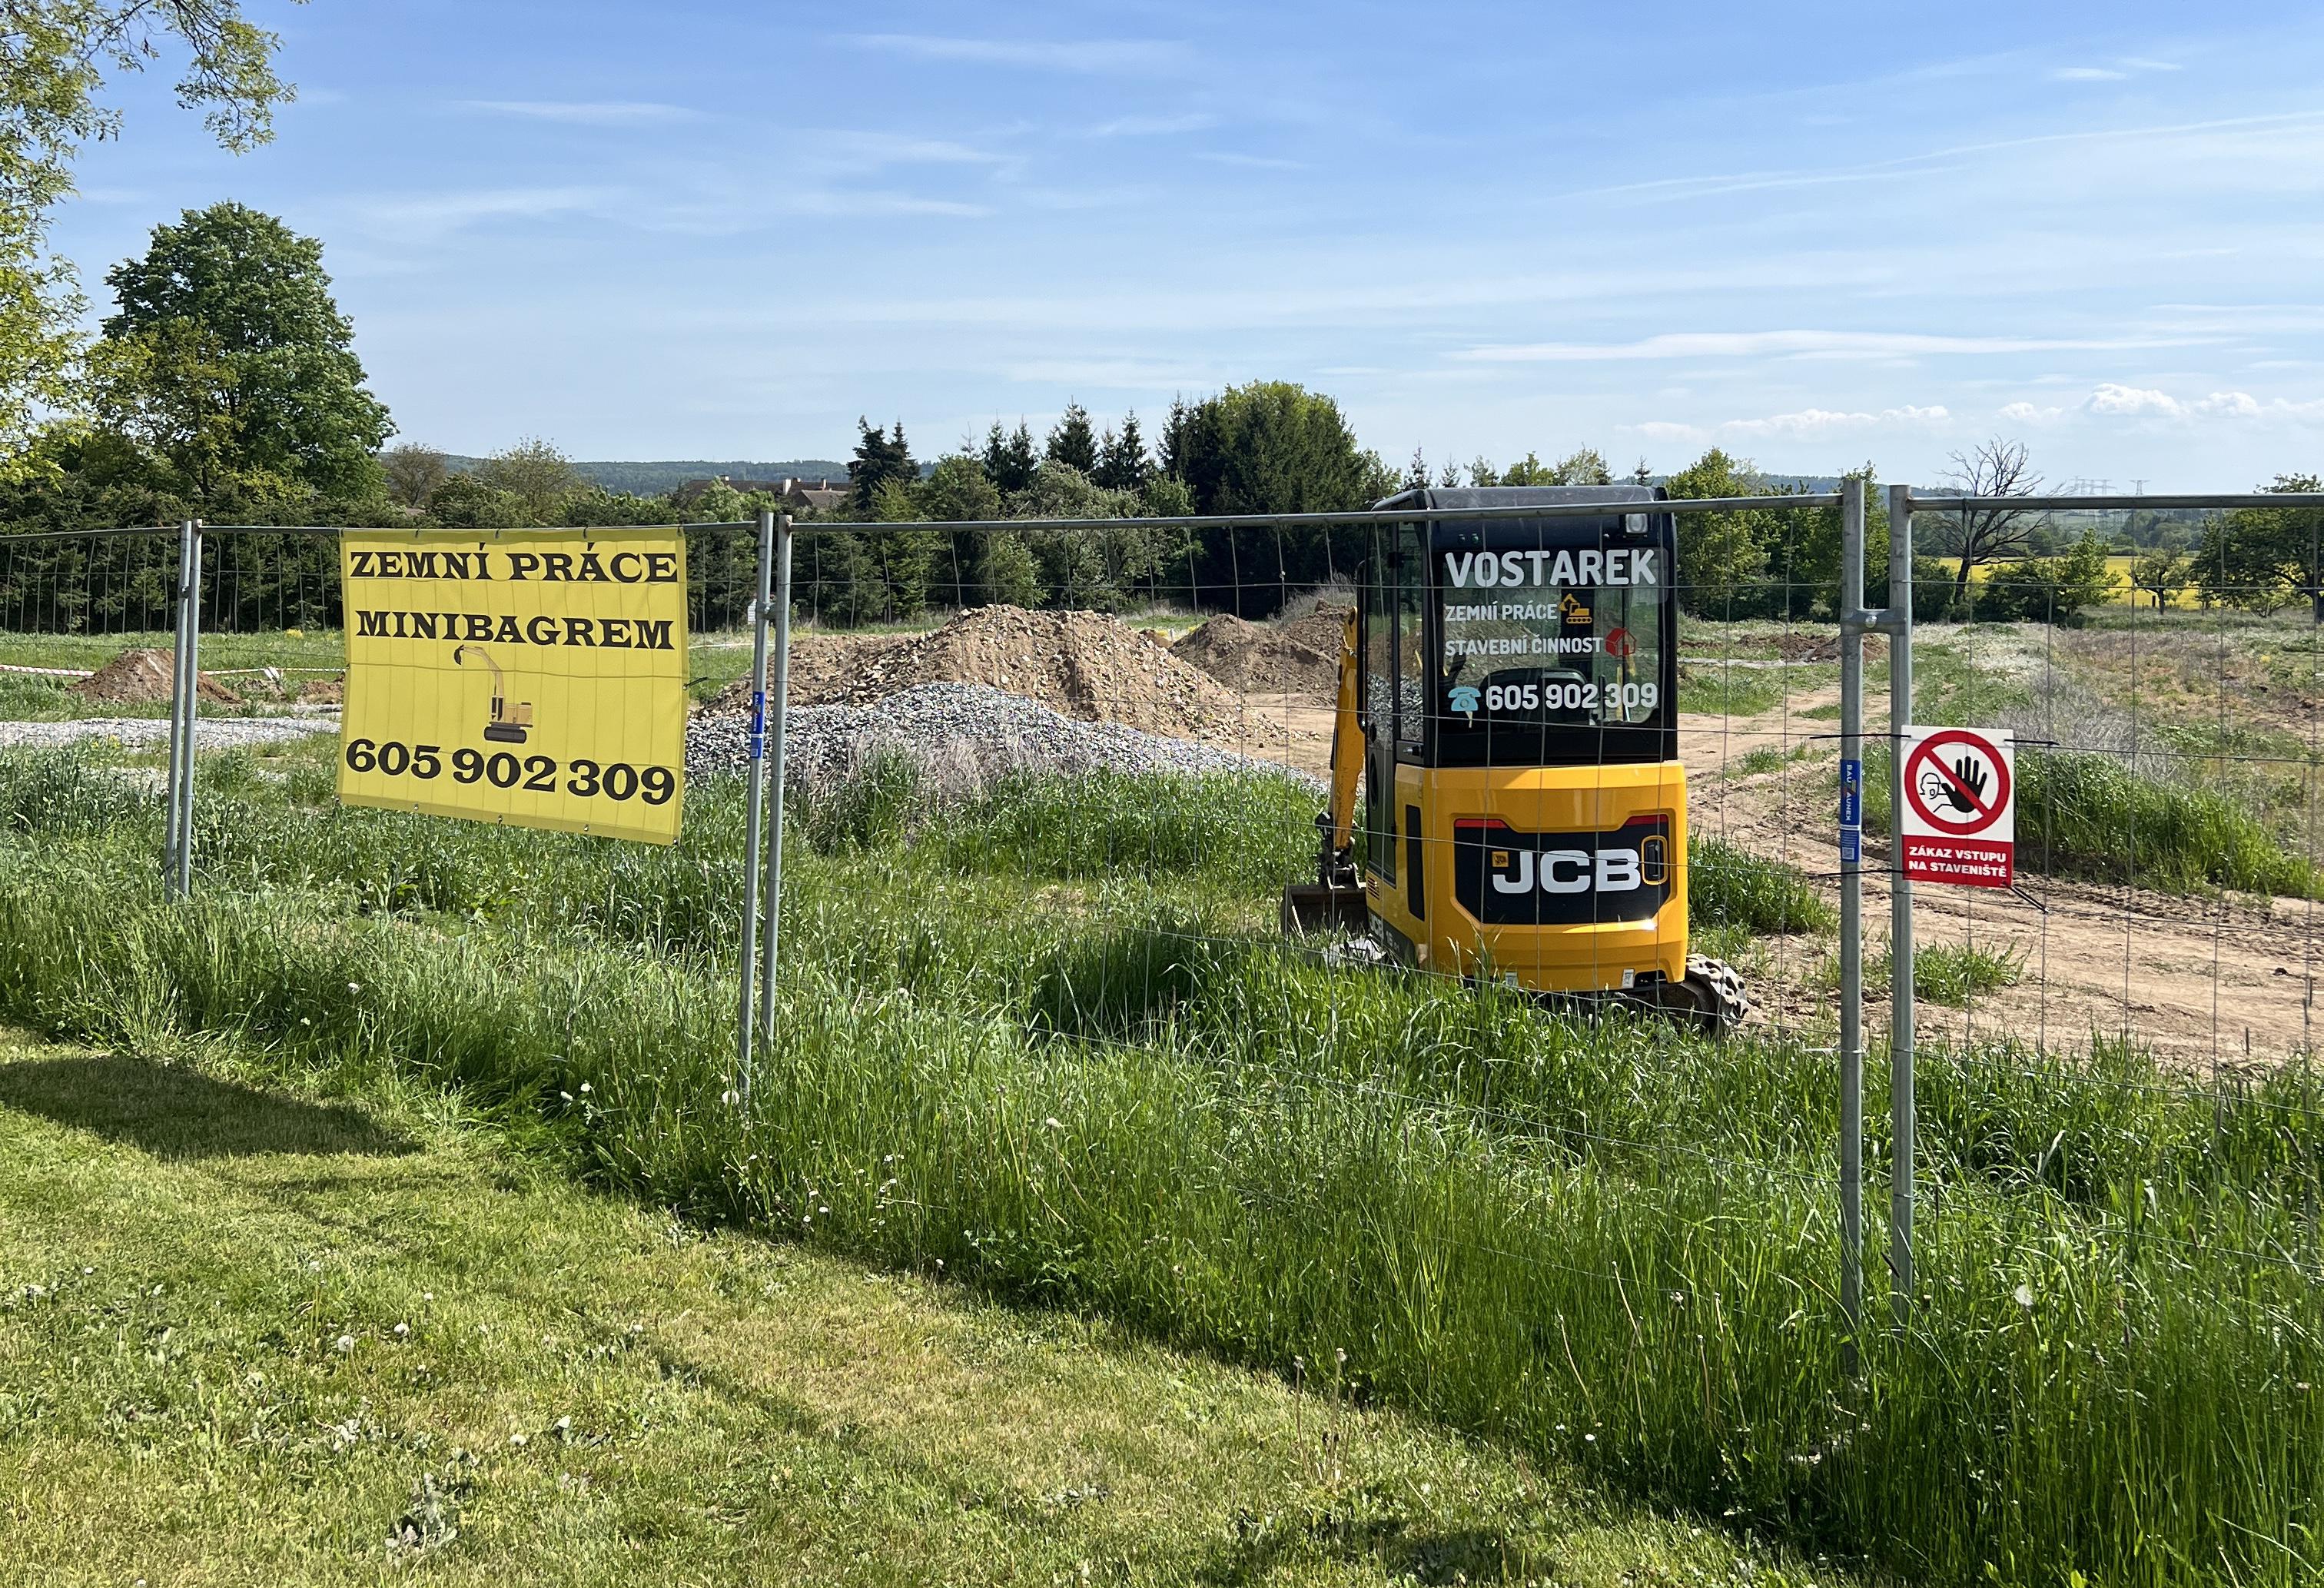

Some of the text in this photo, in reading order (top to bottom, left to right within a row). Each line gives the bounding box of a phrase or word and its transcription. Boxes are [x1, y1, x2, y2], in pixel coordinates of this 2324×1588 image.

[350, 543, 678, 583] ZEMNÍ PRÁCE
[1445, 549, 1656, 588] VOSTAREK
[1445, 600, 1558, 622] ZEMNÍ PRÁCE
[355, 610, 675, 649] MINIBAGREM
[1445, 634, 1603, 656] STAVEBNÍ ČINNOST
[1486, 683, 1658, 710] 605 902 309
[346, 739, 675, 806] 605 902 309
[1909, 845, 2006, 862] ZÁKAZ VSTUPU
[1909, 861, 2007, 877] NA STAVENIŠTĚ
[1492, 849, 1641, 893] JCB
